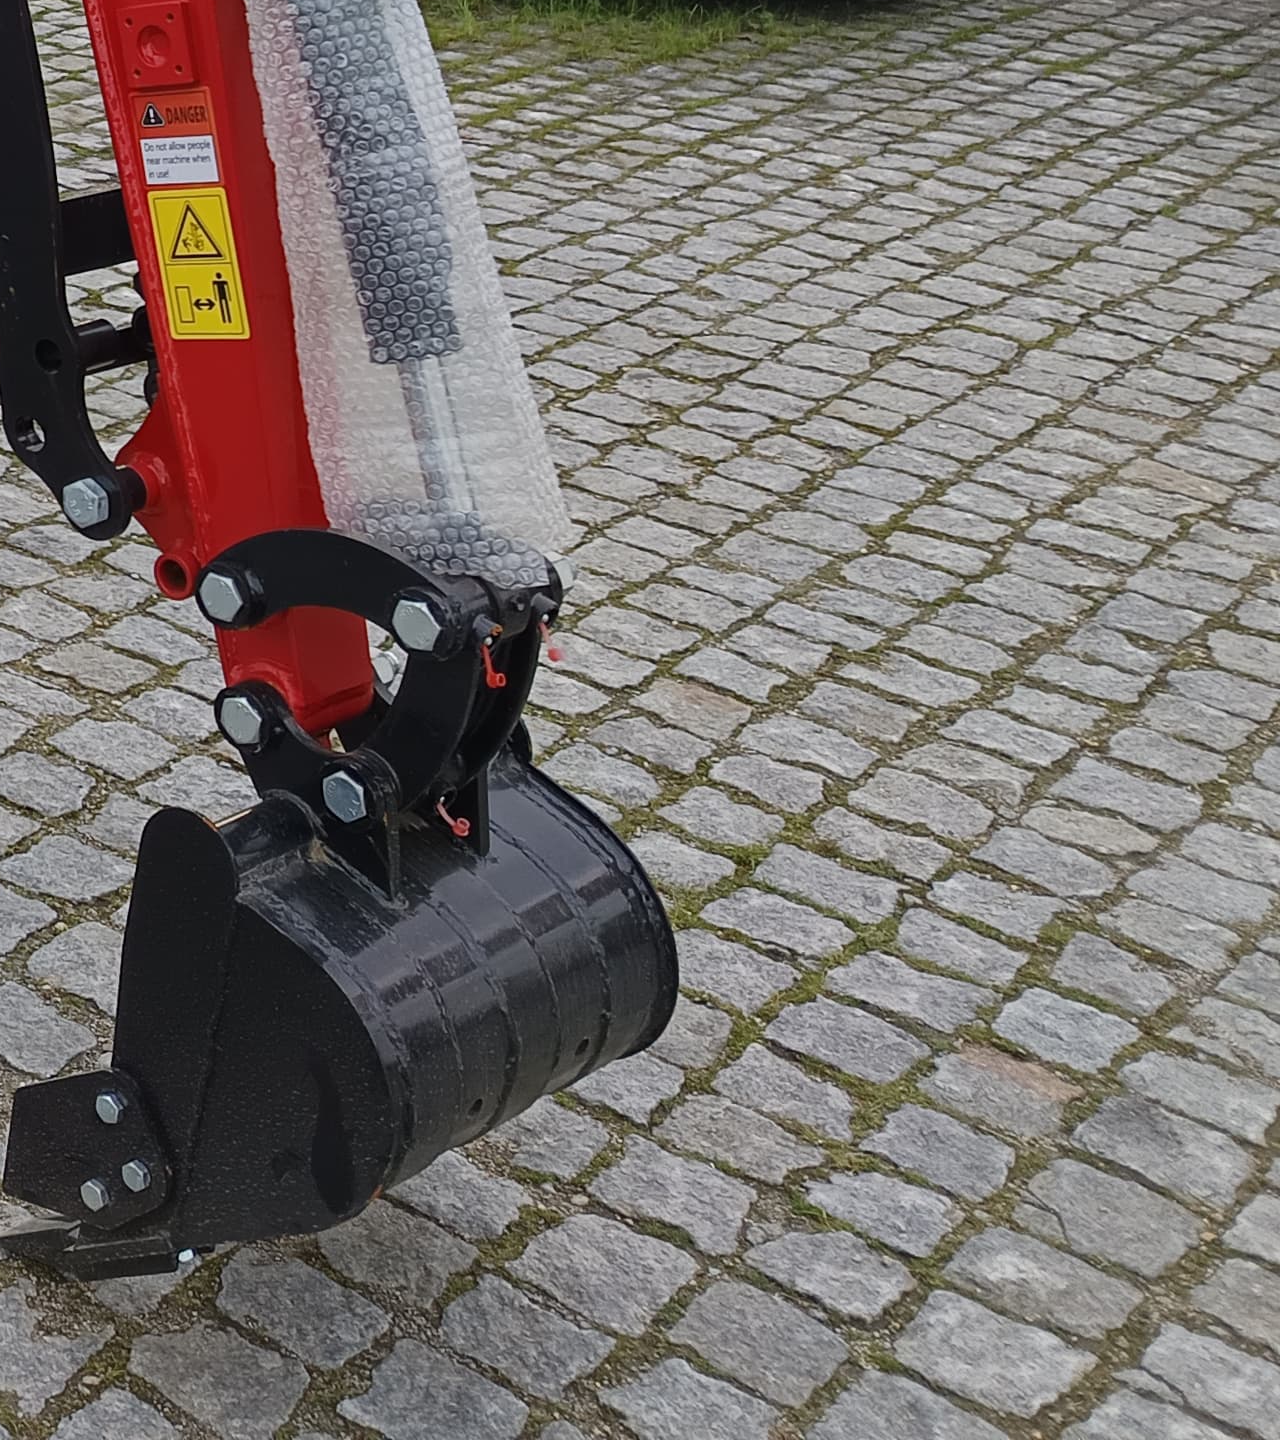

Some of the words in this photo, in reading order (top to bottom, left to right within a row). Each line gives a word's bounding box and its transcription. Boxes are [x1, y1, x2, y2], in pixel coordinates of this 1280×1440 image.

[165, 105, 208, 125] DANGER
[143, 142, 154, 152] Do
[155, 143, 167, 151] not
[168, 141, 186, 151] allow
[187, 140, 211, 152] people
[146, 157, 161, 165] near
[162, 155, 190, 164] machine
[192, 154, 211, 163] when
